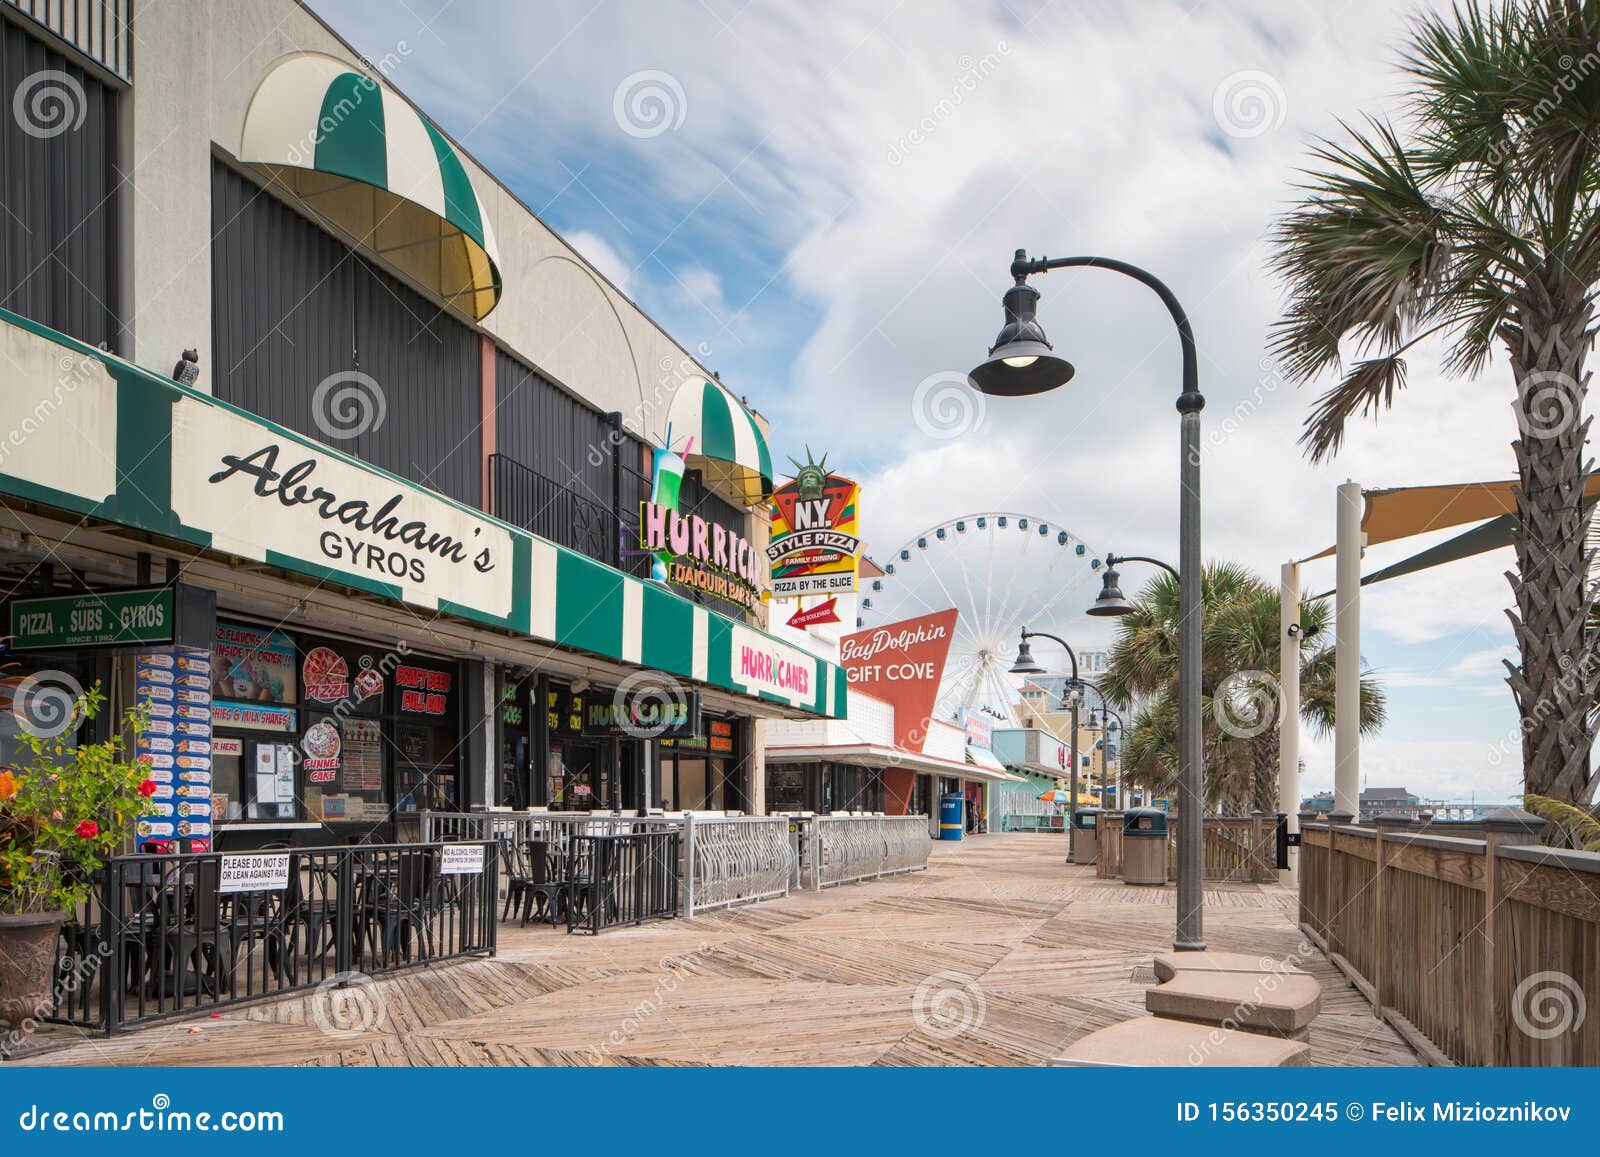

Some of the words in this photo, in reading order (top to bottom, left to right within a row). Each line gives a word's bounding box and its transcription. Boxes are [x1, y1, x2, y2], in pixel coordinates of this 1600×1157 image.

[208, 444, 495, 573] Abraham's
[795, 498, 832, 530] N.Y.
[768, 534, 812, 559] STYLE
[815, 533, 856, 552] PIZZA
[319, 531, 426, 583] GYROS
[785, 556, 811, 565] FAMILY
[812, 554, 838, 562] DINING
[674, 563, 728, 596] DAIQUIRI
[729, 582, 745, 604] BAR
[774, 581, 797, 593] PIZZA
[799, 580, 810, 590] BY
[812, 579, 827, 589] THE
[830, 576, 852, 588] SLICE
[19, 613, 54, 635] PIZZA
[70, 609, 102, 632] SUBS
[120, 603, 164, 629] GYROS
[806, 609, 831, 620] BOULEVARD
[226, 629, 260, 646] FLAVORS
[216, 643, 243, 657] INSIDE
[258, 650, 282, 665] ORDER
[396, 665, 426, 688] DRAFT
[427, 670, 452, 692] BEER
[741, 645, 809, 695] HURRICANES
[847, 665, 881, 683] GIFT
[886, 662, 934, 680] COVE
[305, 684, 349, 699] PIZZA
[402, 691, 425, 712] FULL
[427, 694, 446, 715] BAR
[233, 709, 239, 720] &
[241, 710, 259, 722] MILK
[589, 703, 688, 727] HURRICANES
[221, 743, 238, 751] HERE
[304, 758, 341, 769] FUNNEL
[310, 771, 336, 781] CAKE
[223, 858, 250, 868] PLEASE
[252, 858, 262, 868] DO
[263, 858, 276, 867] NOT
[278, 857, 288, 867] SIT
[223, 871, 231, 879] OR
[233, 870, 248, 879] LEAN
[250, 869, 273, 878] AGAINST
[275, 868, 287, 877] RAIL
